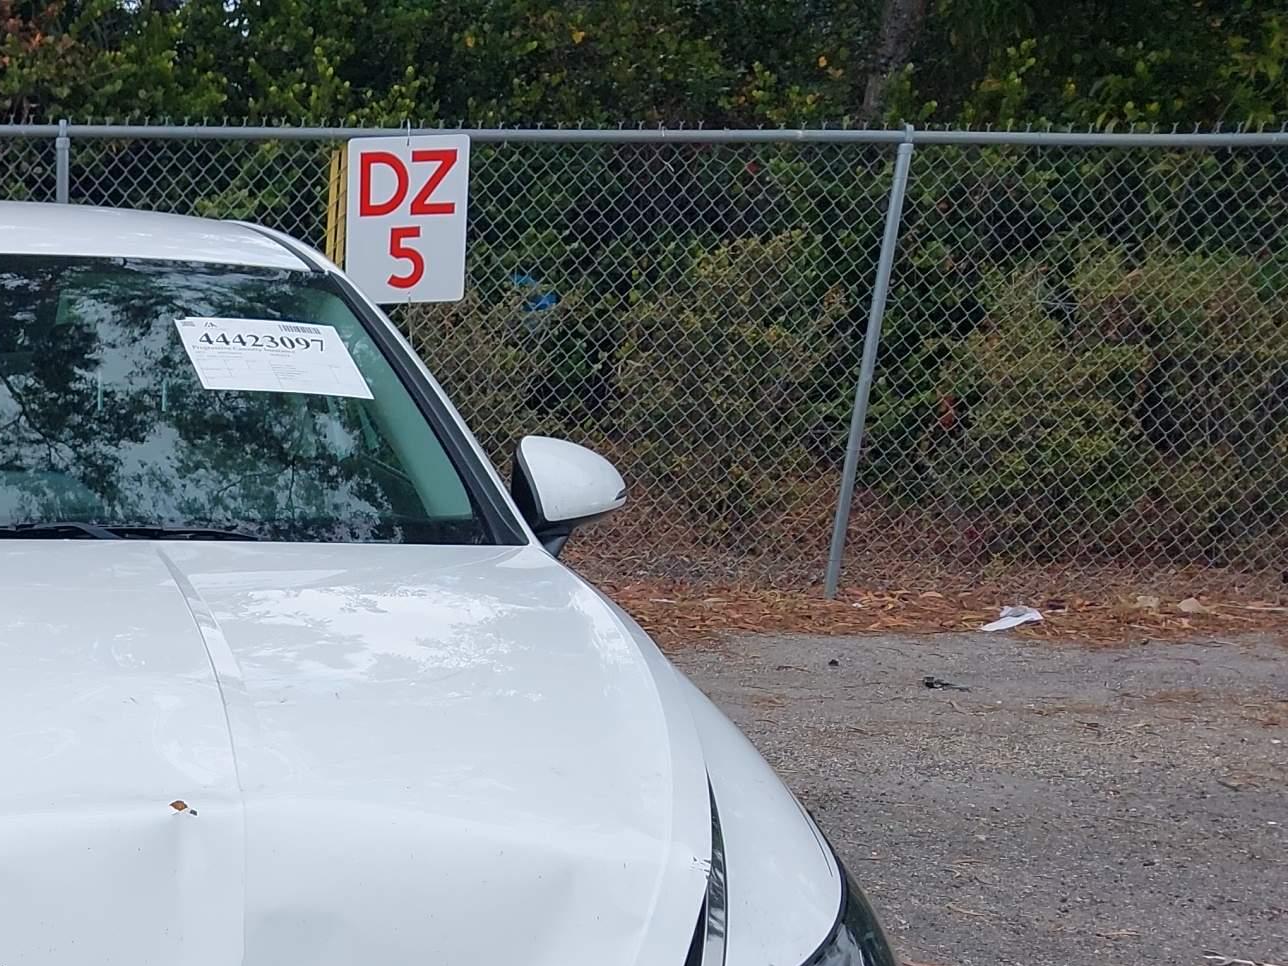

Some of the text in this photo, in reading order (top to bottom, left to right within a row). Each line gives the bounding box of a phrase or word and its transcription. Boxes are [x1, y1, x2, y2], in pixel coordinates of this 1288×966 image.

[359, 148, 459, 218] DZ
[386, 225, 426, 290] 5
[198, 331, 325, 353] 44423097
